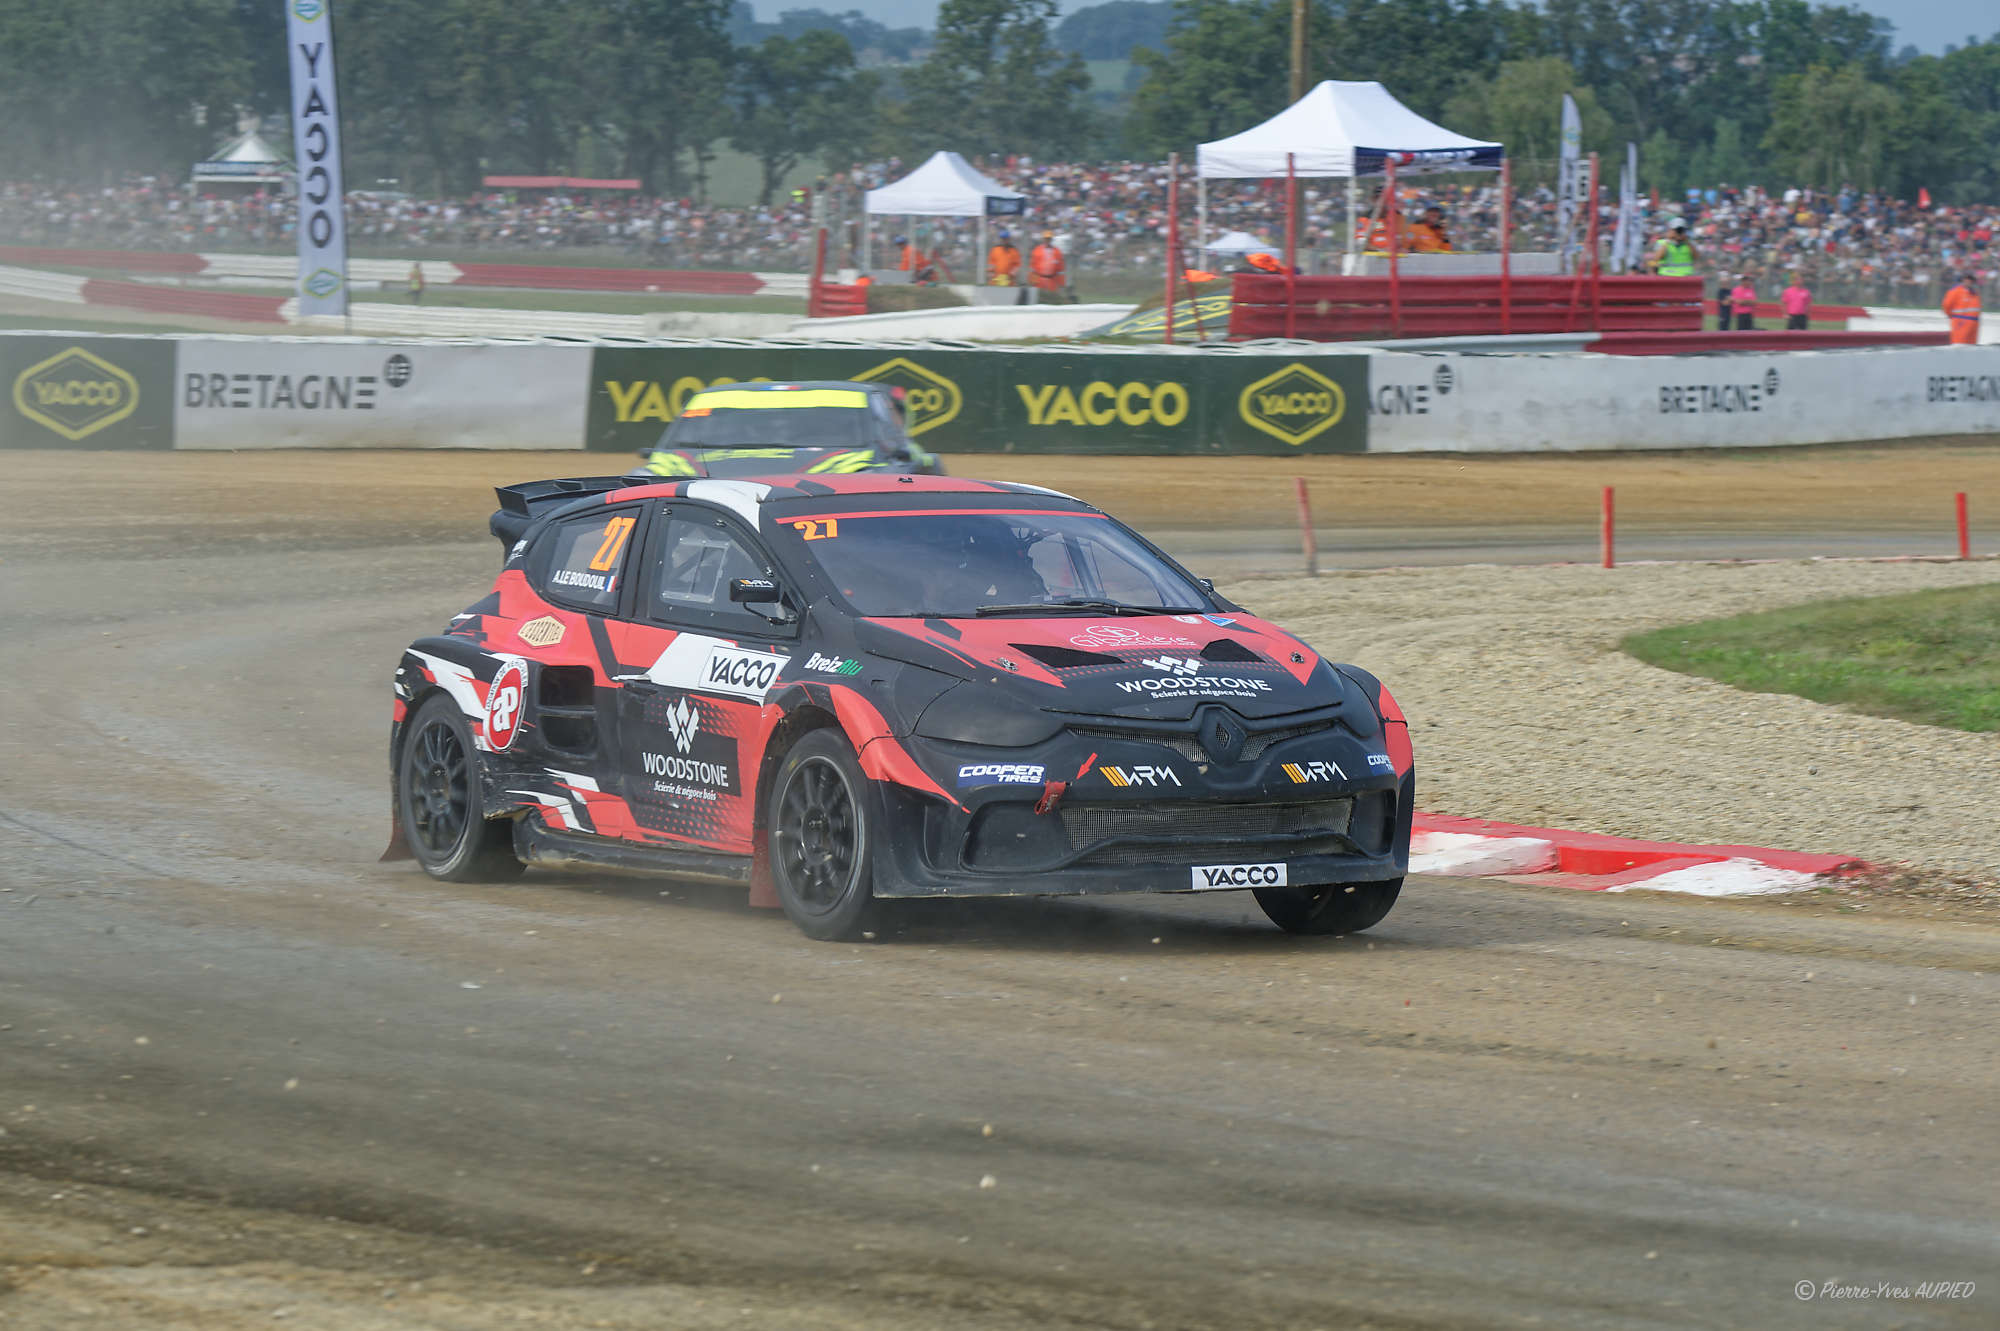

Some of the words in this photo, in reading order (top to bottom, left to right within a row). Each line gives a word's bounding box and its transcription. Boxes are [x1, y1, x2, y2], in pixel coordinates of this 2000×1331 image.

[32, 380, 121, 406] YACCO
[184, 372, 379, 410] BRETAGNE
[604, 376, 774, 423] YAC
[1015, 381, 1190, 427] YACCO
[1257, 391, 1331, 417] YACCO
[1658, 384, 1761, 414] BRETAGNE
[792, 518, 838, 541] 27
[590, 516, 636, 571] 27
[708, 655, 777, 690] YACCO
[1115, 676, 1273, 693] WOODSTONE
[1234, 688, 1257, 698] bois
[642, 751, 729, 788] WOODSTONE
[958, 764, 1045, 778] COOPER
[997, 774, 1042, 784] TIRES
[703, 788, 718, 801] bois
[1200, 865, 1279, 887] YACCO
